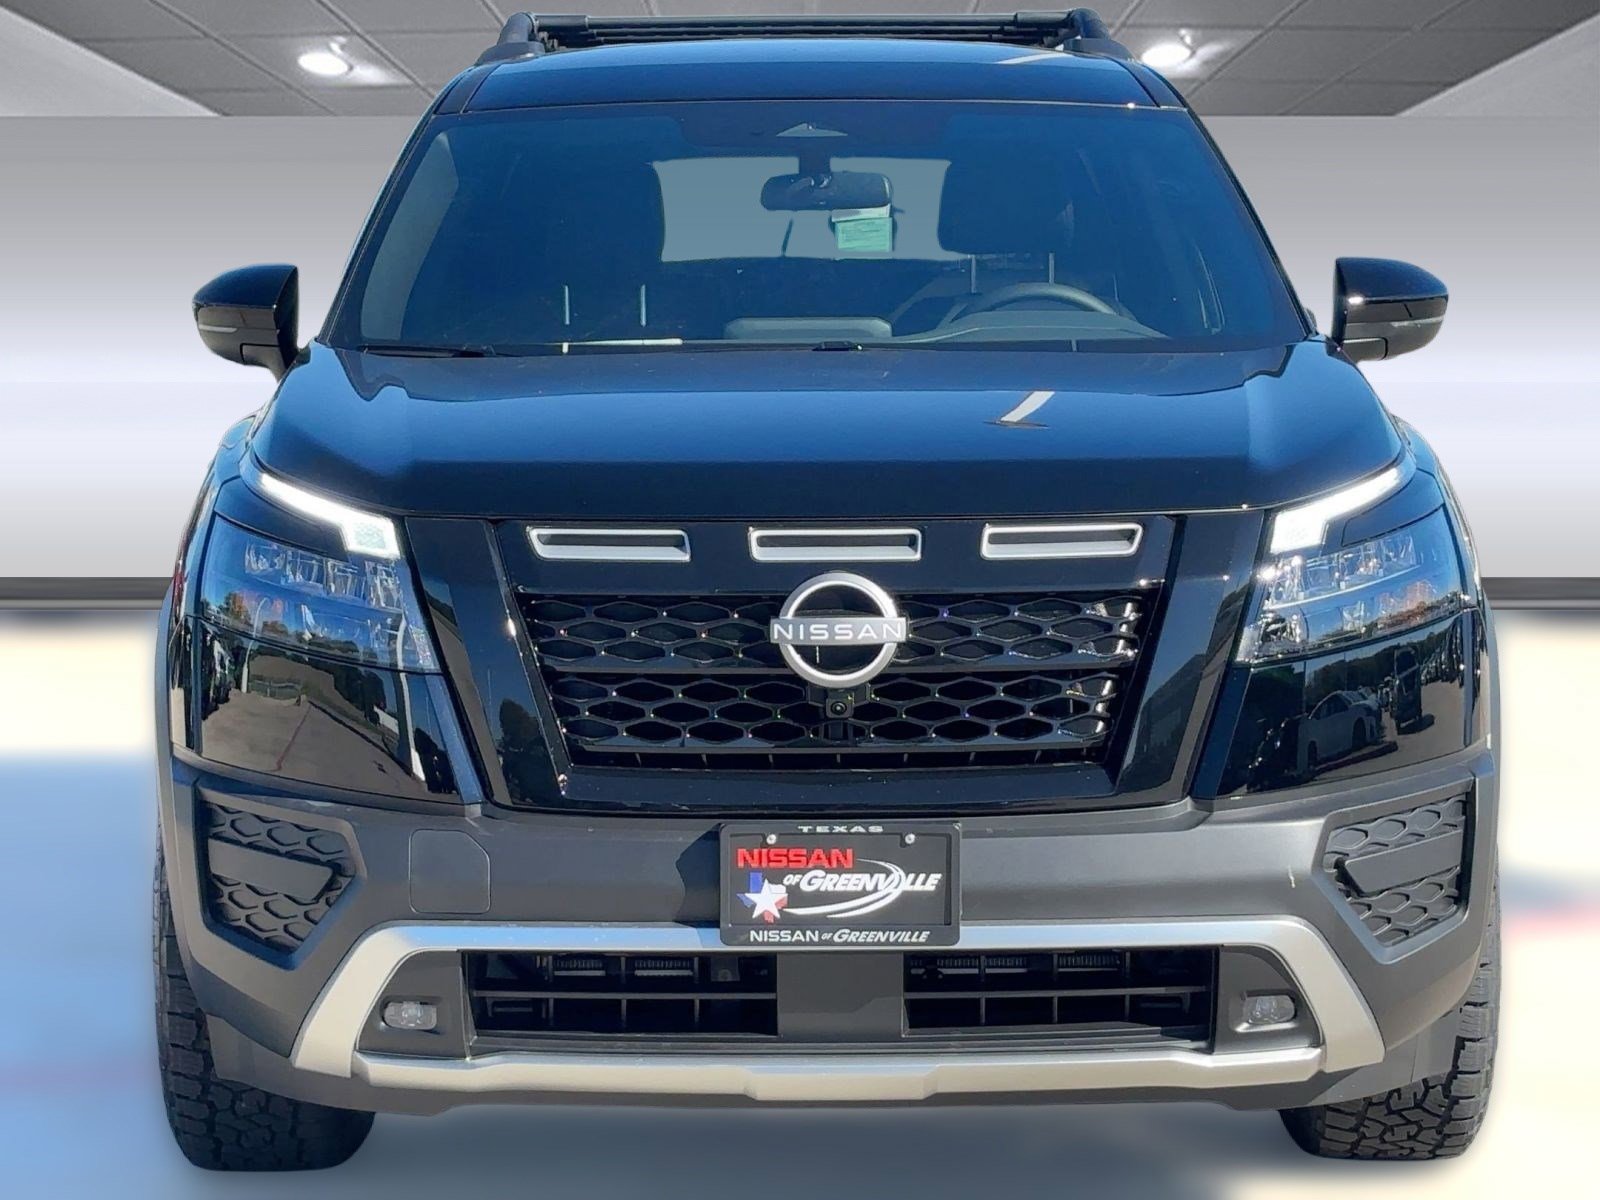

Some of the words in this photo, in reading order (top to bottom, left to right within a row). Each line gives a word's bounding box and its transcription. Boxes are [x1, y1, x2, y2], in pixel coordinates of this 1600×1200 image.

[773, 623, 902, 640] NISSAN
[798, 825, 883, 833] TEXAS
[737, 848, 853, 869] NISSAN
[750, 930, 819, 943] NISSAN
[833, 928, 931, 943] GREENVILLE
